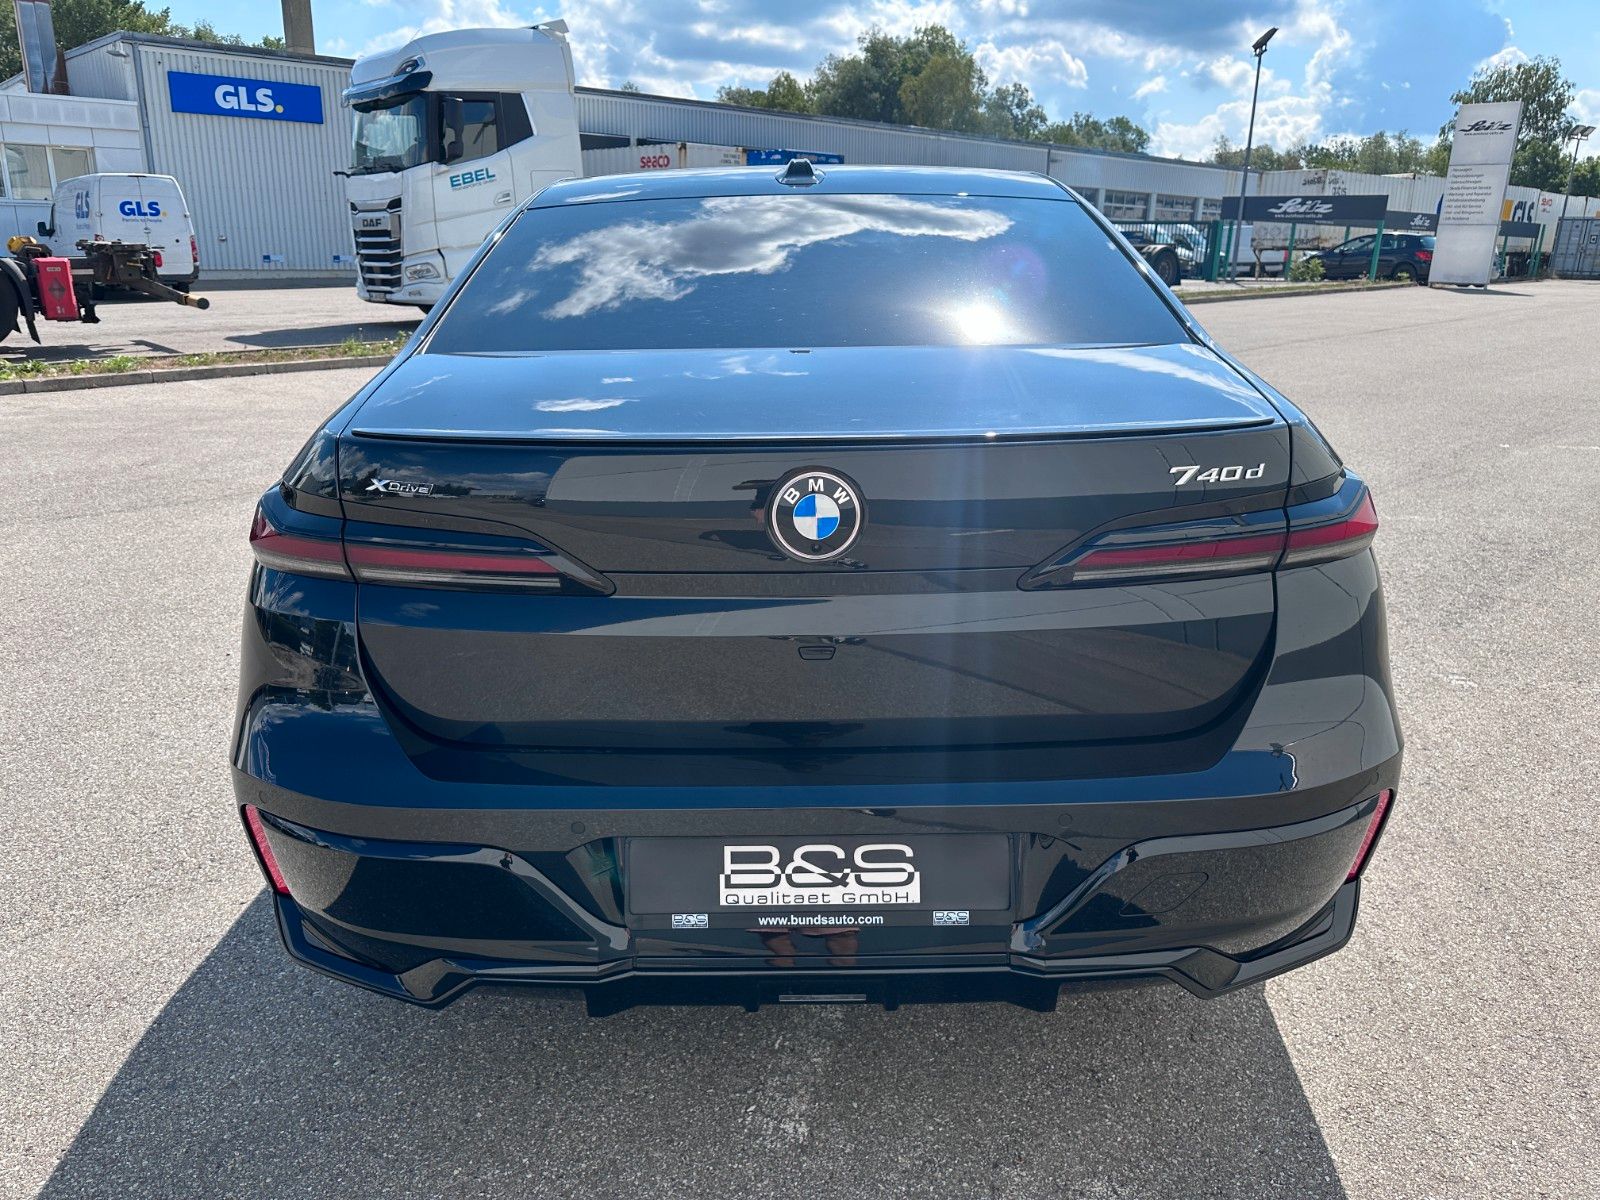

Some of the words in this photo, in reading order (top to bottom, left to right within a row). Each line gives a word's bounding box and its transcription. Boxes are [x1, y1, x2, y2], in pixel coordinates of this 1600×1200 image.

[640, 154, 671, 168] seaco
[449, 167, 497, 188] EBEL
[362, 218, 382, 227] DAF
[783, 478, 850, 505] BMW
[724, 844, 915, 889] B&S
[725, 891, 831, 905] Qualitaet
[758, 914, 884, 926] www.bundsauto.com
